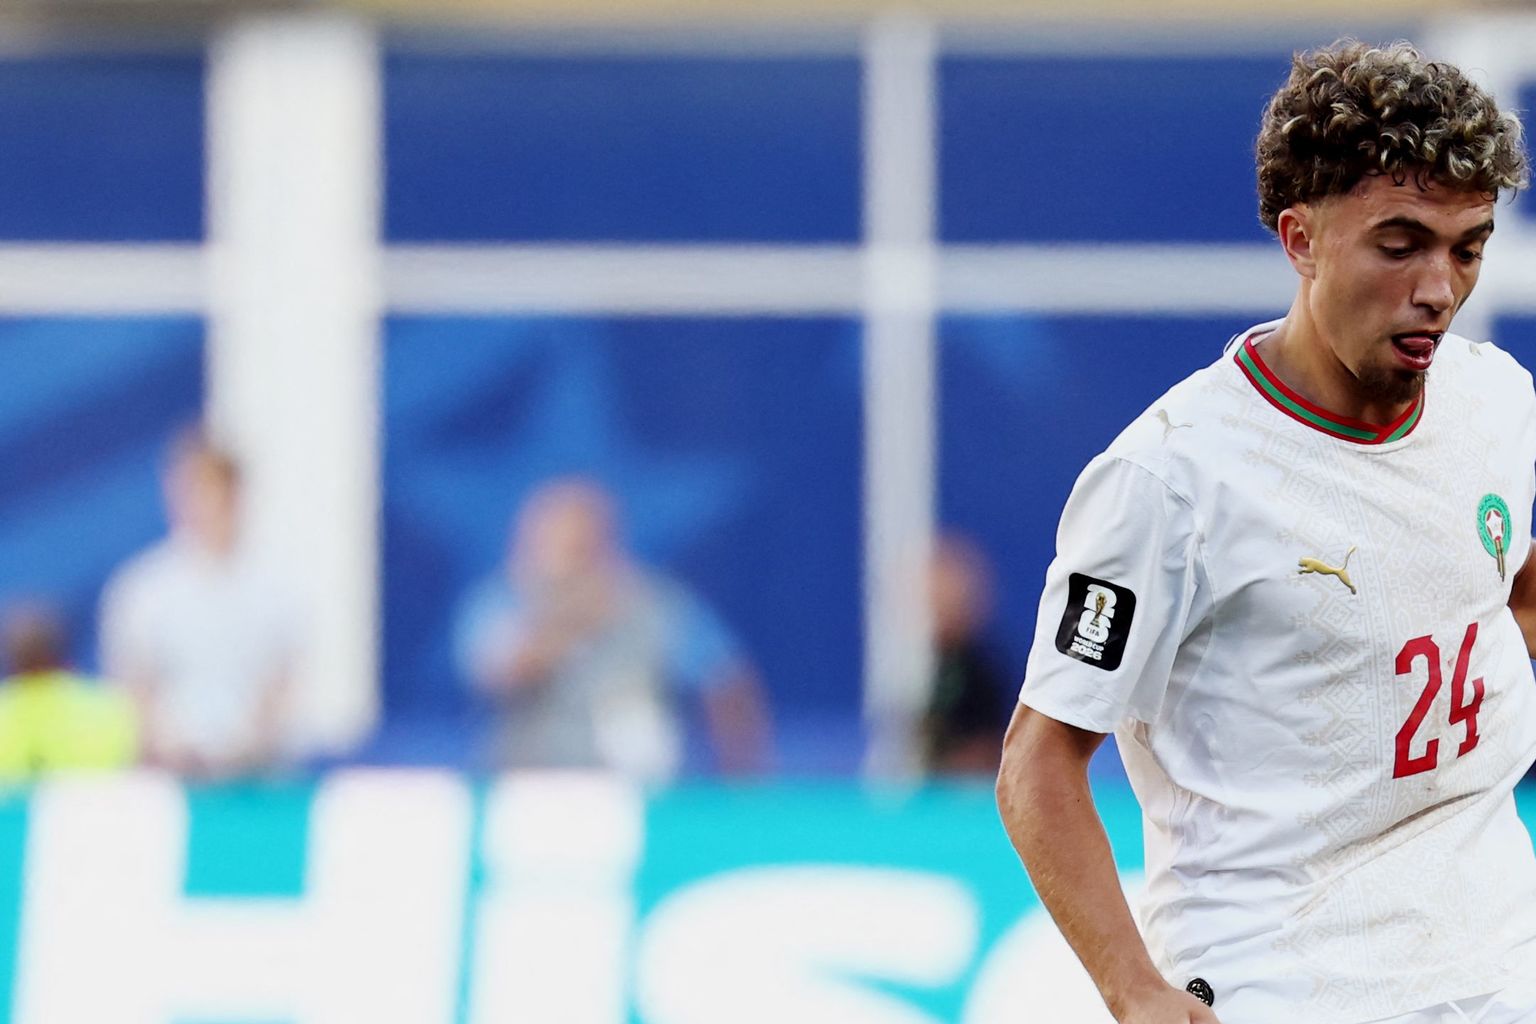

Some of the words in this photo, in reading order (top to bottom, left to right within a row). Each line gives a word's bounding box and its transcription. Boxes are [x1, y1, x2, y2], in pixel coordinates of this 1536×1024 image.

[1086, 627, 1100, 637] FIFA
[1070, 642, 1102, 660] 2026
[1393, 622, 1484, 779] 24
